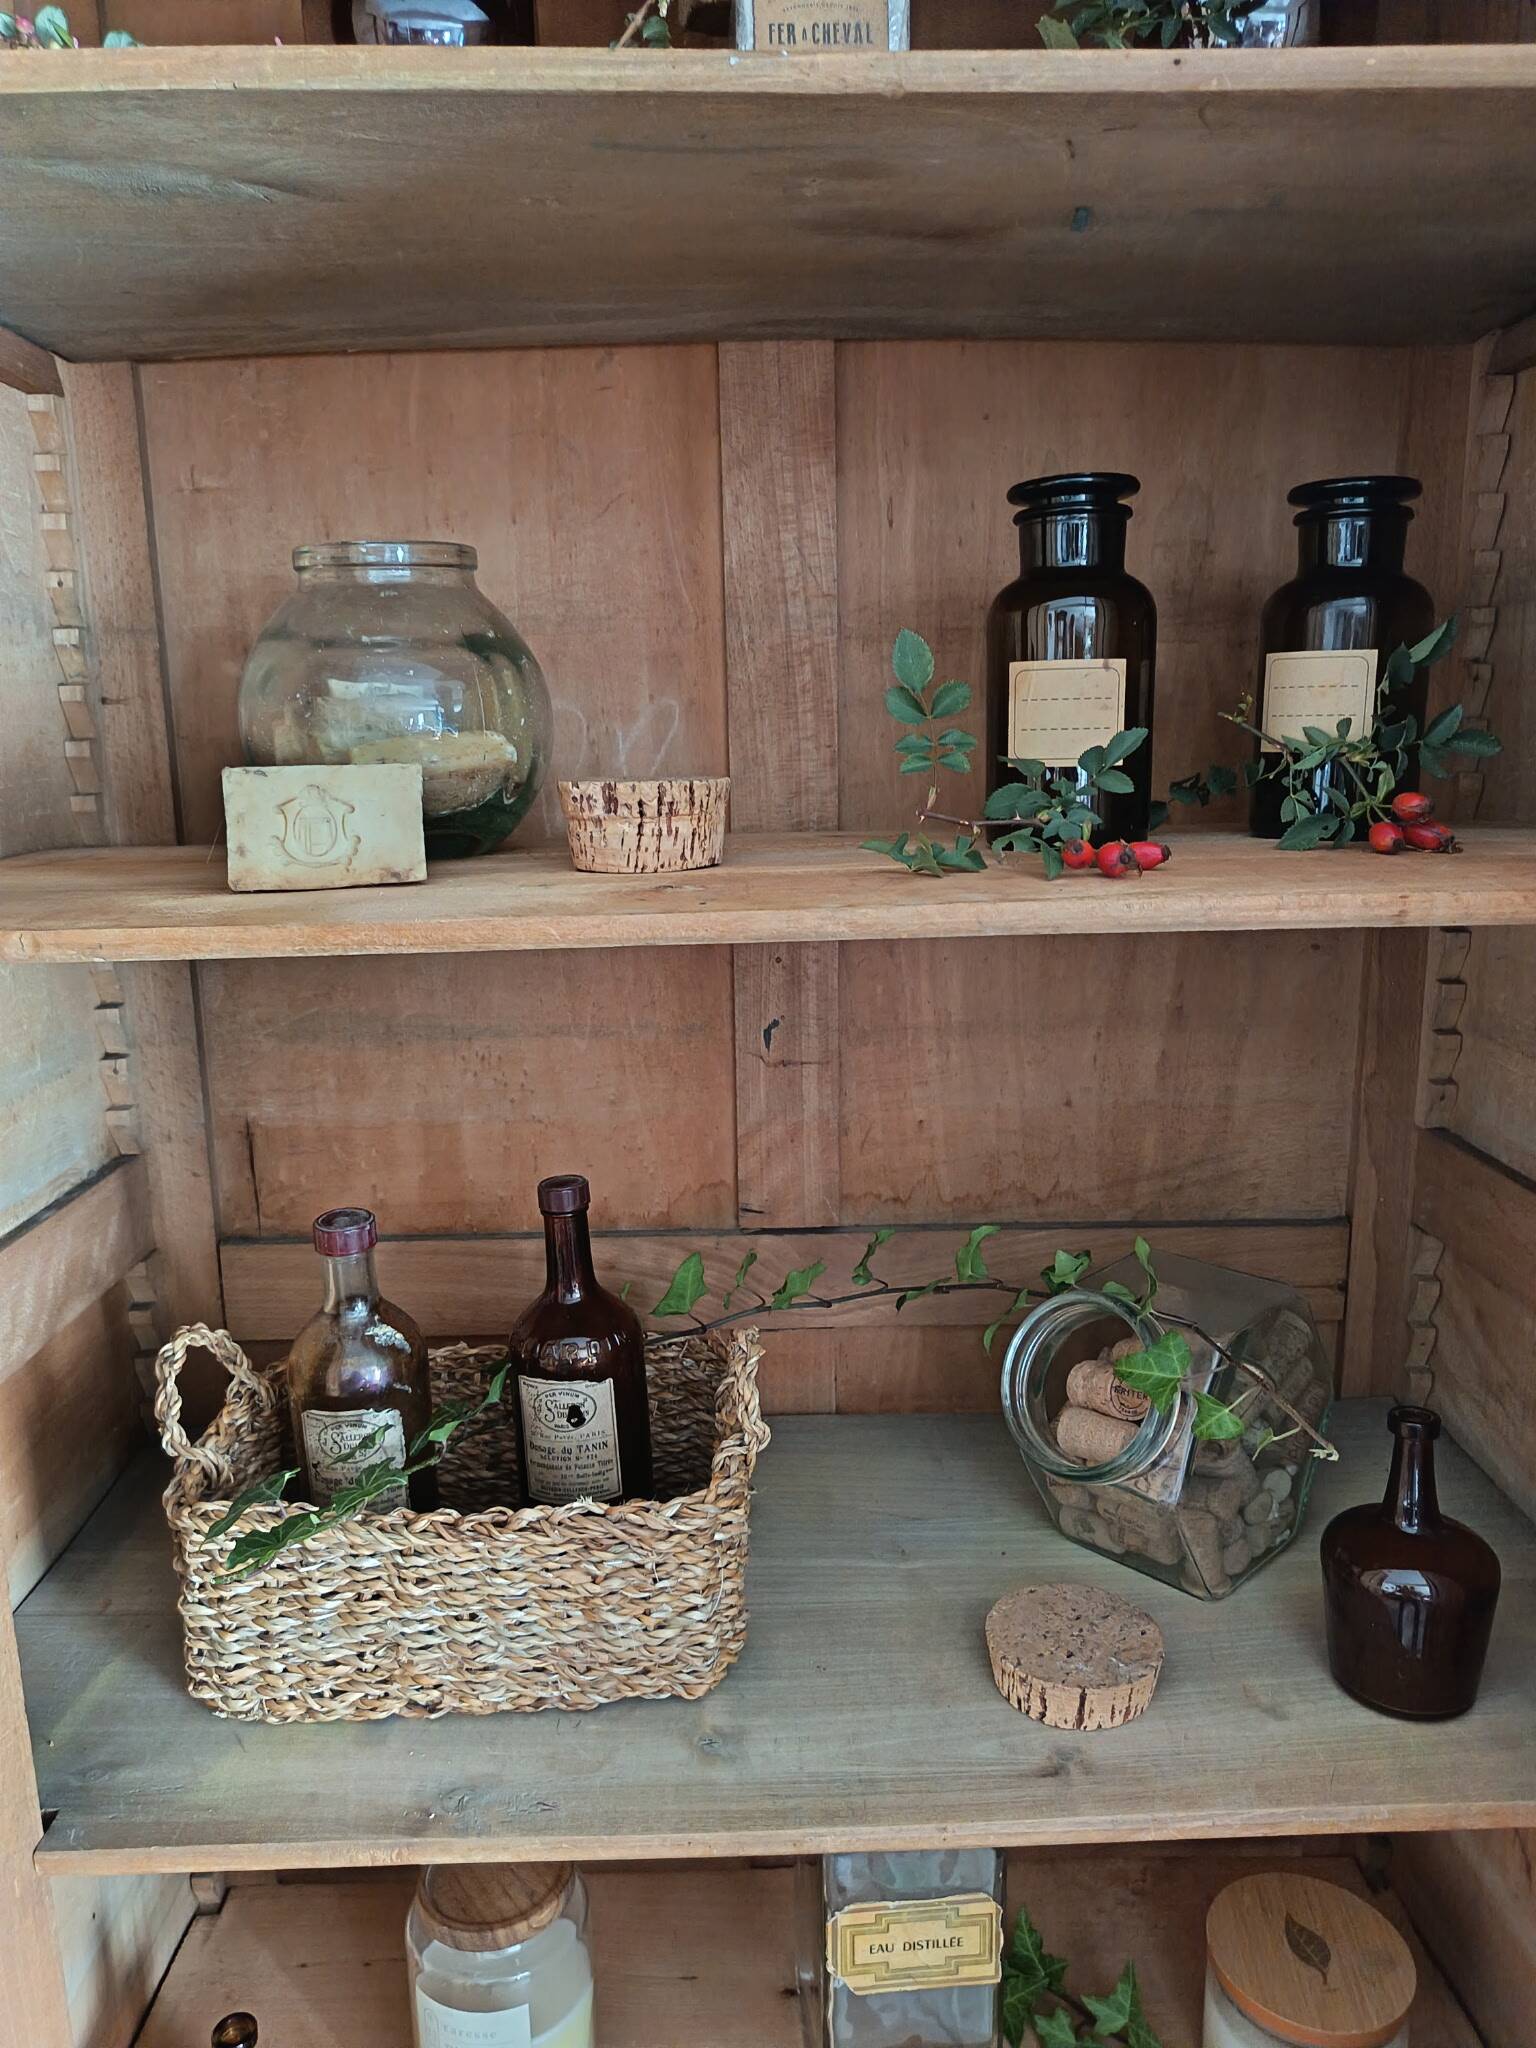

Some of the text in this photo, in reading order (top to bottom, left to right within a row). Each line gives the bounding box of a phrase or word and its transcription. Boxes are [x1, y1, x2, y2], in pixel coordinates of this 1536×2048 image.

[768, 22, 797, 45] FER
[811, 22, 874, 45] CHEVAL
[577, 1440, 609, 1454] TANIN
[869, 1936, 964, 1955] EAU DISTILLÉE
